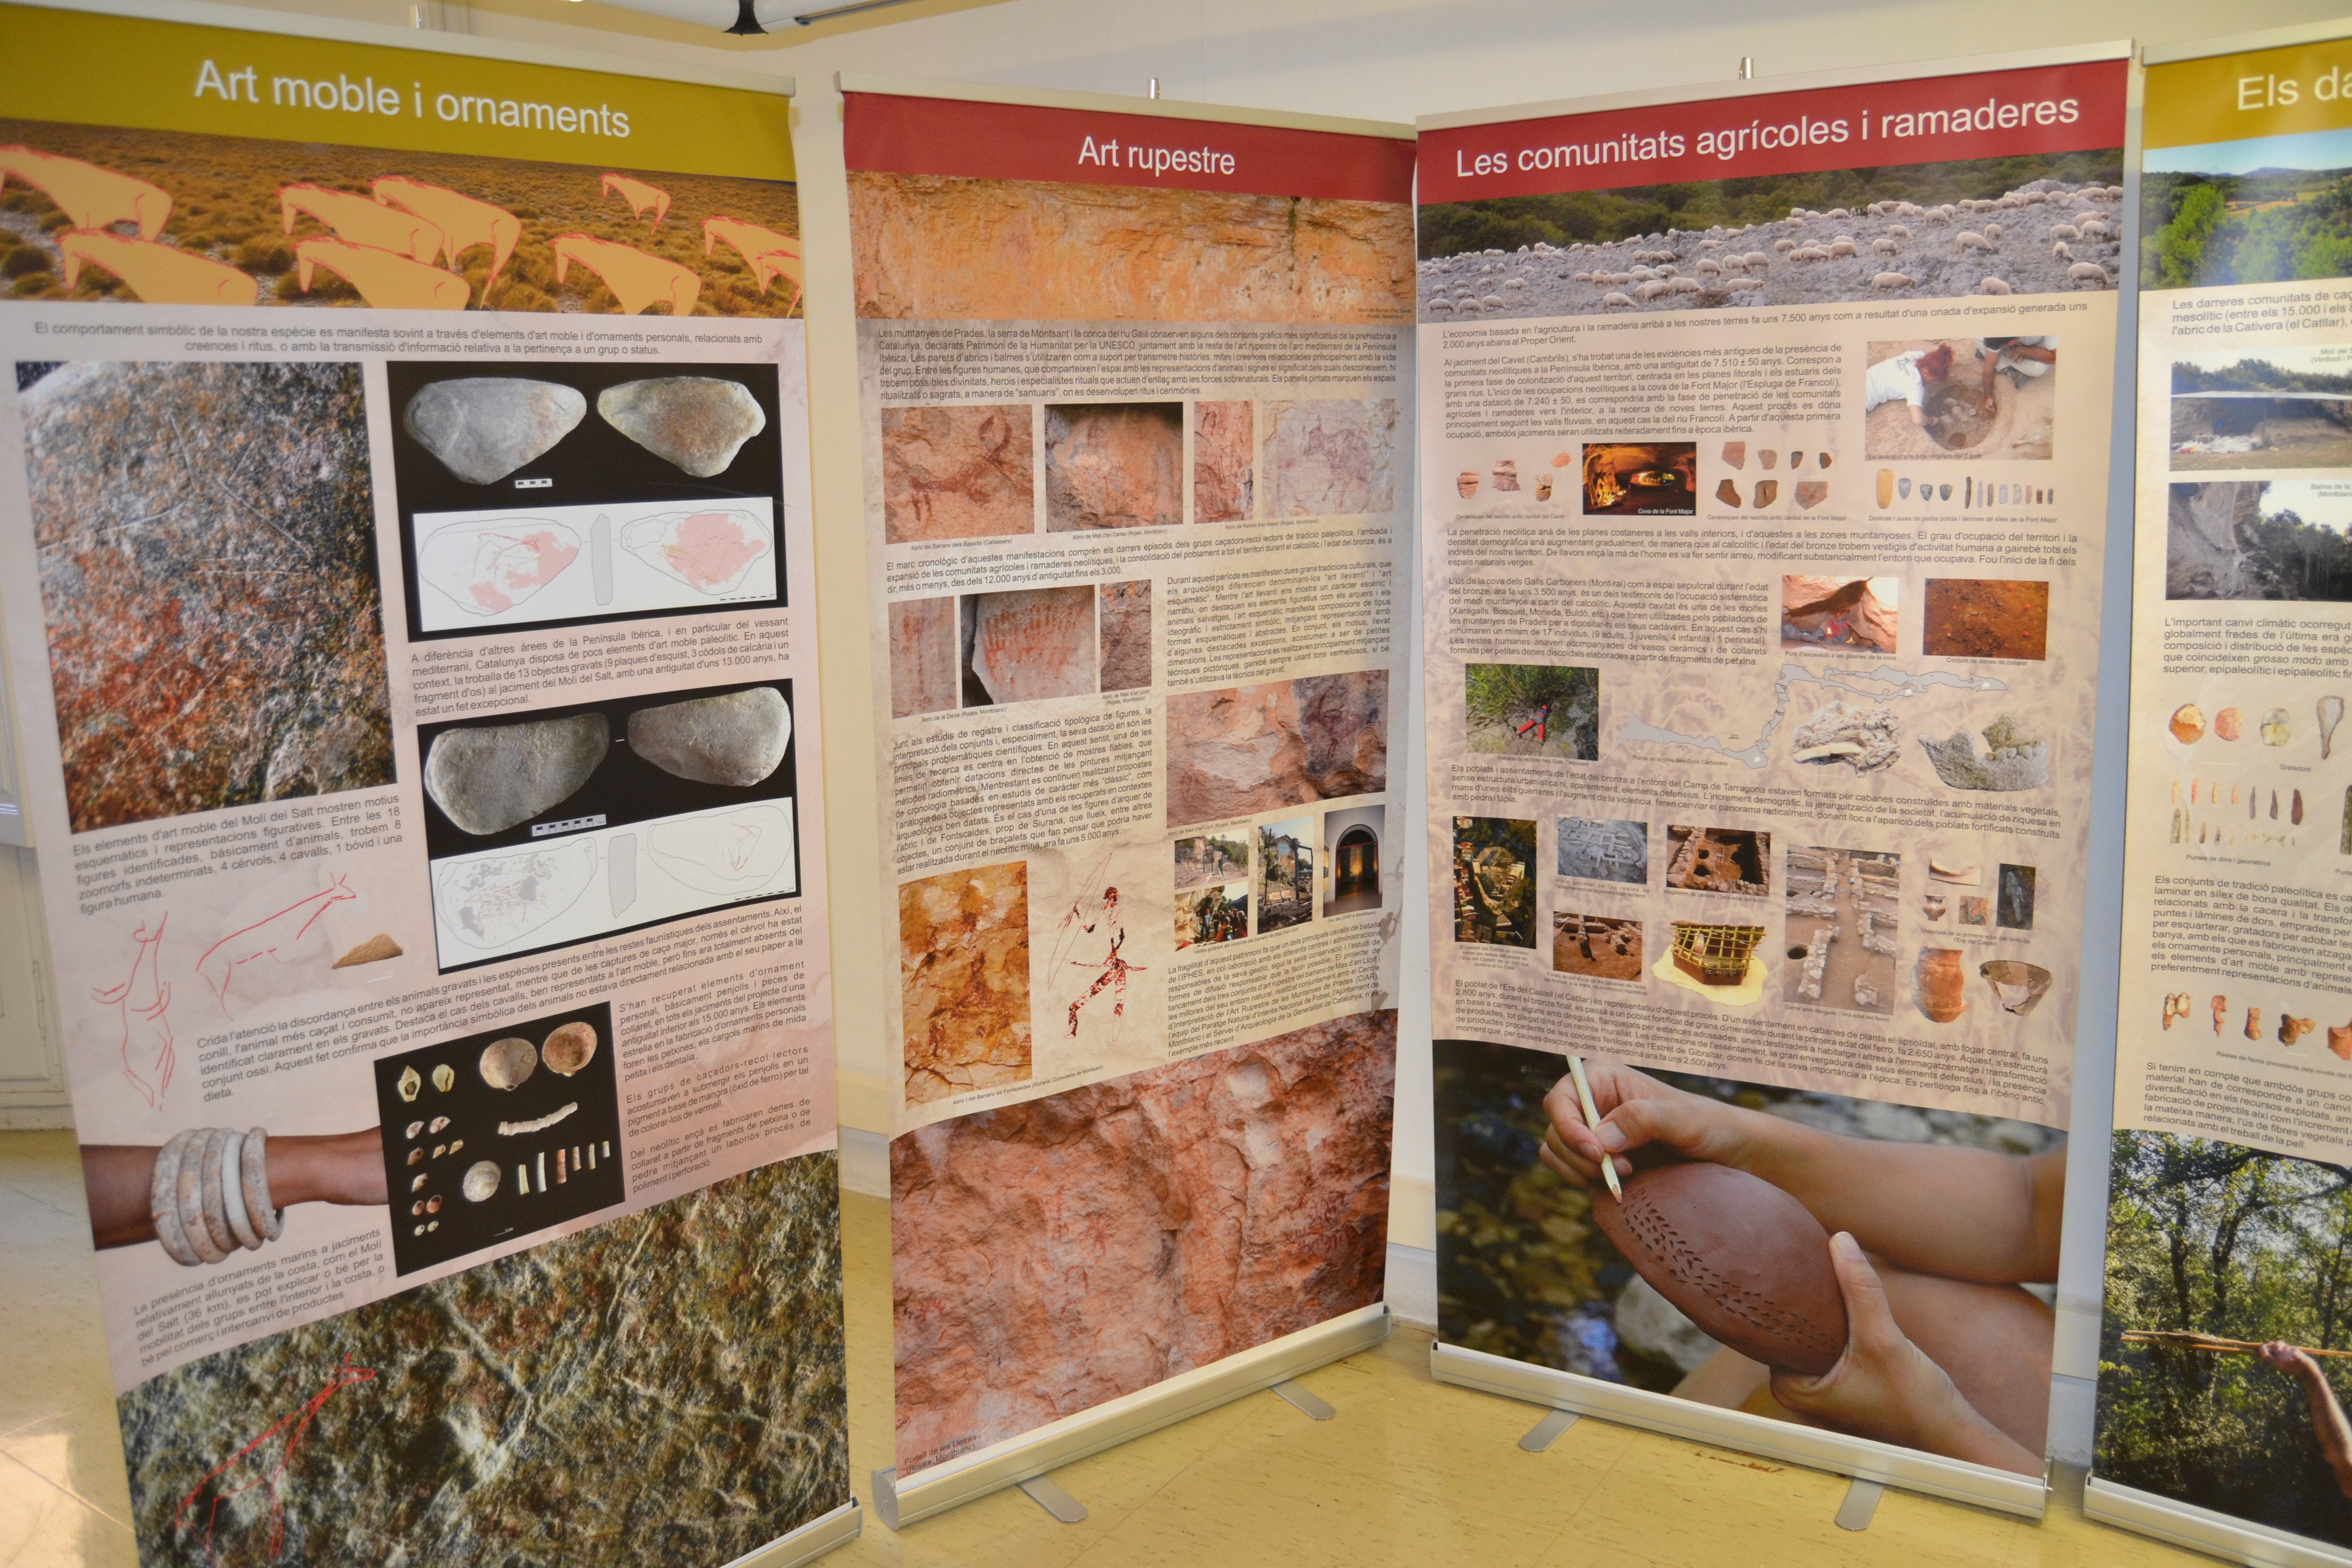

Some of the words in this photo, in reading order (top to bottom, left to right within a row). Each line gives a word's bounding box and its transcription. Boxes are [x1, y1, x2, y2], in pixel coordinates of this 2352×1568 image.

[195, 60, 259, 103] Art
[273, 74, 400, 116] moble
[414, 82, 422, 118] i
[436, 93, 630, 137] ornaments
[2239, 75, 2299, 110] Els
[1457, 150, 1508, 177] Les
[1518, 130, 1685, 171] comunitats
[1697, 116, 1849, 160] agrícoles
[1863, 110, 1868, 140] i
[1882, 98, 2078, 138] ramaderes
[1078, 136, 1119, 167] Art
[1129, 146, 1235, 177] rupestre
[2207, 324, 2221, 334] de
[2223, 323, 2233, 333] la
[2235, 322, 2283, 332] Cativera
[2286, 319, 2299, 331] (el
[2302, 317, 2347, 329] Catllar),
[185, 342, 239, 351] creences
[242, 340, 244, 351] i
[248, 340, 276, 352] ritus,
[280, 343, 288, 352] o
[291, 341, 316, 352] amb
[320, 341, 330, 352] la
[333, 341, 395, 352] transmissió
[464, 343, 501, 353] relativa
[513, 343, 521, 353] la
[524, 344, 572, 356] pertinença
[598, 347, 619, 356] grup
[631, 346, 660, 354] status.
[1443, 340, 1464, 349] 2.000
[1466, 340, 1485, 349] anys
[1512, 337, 1519, 346] al
[1521, 337, 1548, 346] Proper
[1549, 335, 1576, 344] Orient.
[881, 389, 922, 400] ritualitzats
[929, 390, 963, 401] sagrats,
[1004, 388, 1014, 397] de
[1086, 386, 1138, 397] desenvolupen
[1140, 386, 1155, 395] ritus
[1157, 386, 1158, 395] i
[1160, 386, 1202, 395] cerimònies.
[1448, 558, 1473, 567] espais
[1475, 558, 1506, 567] naturals
[888, 585, 897, 594] dir,
[899, 582, 914, 592] més
[922, 581, 949, 590] menys,
[951, 578, 965, 587] des
[967, 576, 983, 585] dels
[985, 574, 1011, 584] 12.000
[1012, 574, 1031, 583] anys
[1075, 569, 1088, 577] fins
[1090, 568, 1100, 576] els
[1101, 566, 1122, 576] 3.000.
[1167, 677, 1189, 687] també
[1233, 670, 1255, 679] tècnica
[1256, 668, 1264, 676] del
[1265, 665, 1285, 676] gravat.
[415, 705, 440, 717] estat
[442, 705, 454, 714] un
[456, 701, 469, 711] fet
[470, 696, 531, 710] excepcional.
[2280, 764, 2311, 772] Gratadors
[1471, 794, 1492, 802] pedra
[1497, 794, 1517, 804] tàpia.
[73, 844, 91, 856] Els
[94, 834, 148, 852] elements
[181, 822, 216, 836] moble
[220, 817, 238, 829] del
[242, 813, 266, 826] Molí
[270, 810, 287, 822] del
[292, 806, 313, 819] Salt
[317, 801, 361, 815] mostren
[365, 795, 399, 807] motius
[652, 984, 696, 1003] recuperat
[702, 973, 743, 990] elements
[1199, 1041, 1213, 1049] més
[1214, 1036, 1235, 1046] recent.
[1487, 1028, 1503, 1036] que,
[1517, 1032, 1542, 1042] causes
[1543, 1036, 1598, 1052] desconegudes,
[1659, 1053, 1666, 1061] fa
[1683, 1057, 1706, 1067] 2.500
[1707, 1061, 1728, 1070] anys.
[204, 1089, 234, 1102] dieta.
[2144, 1114, 2196, 1127] relacionats
[2197, 1122, 2218, 1131] amb
[2231, 1127, 2260, 1140] treball
[2262, 1134, 2274, 1142] de
[2276, 1136, 2284, 1145] la
[2286, 1140, 2306, 1148] pell.
[134, 1304, 148, 1316] La
[151, 1282, 204, 1310] presència
[281, 1249, 317, 1265] marins
[332, 1230, 380, 1253] jaciments
[904, 1451, 926, 1465] Portell
[940, 1444, 950, 1452] les
[952, 1435, 976, 1448] Lletres
[935, 1444, 975, 1462] Montblanc)
